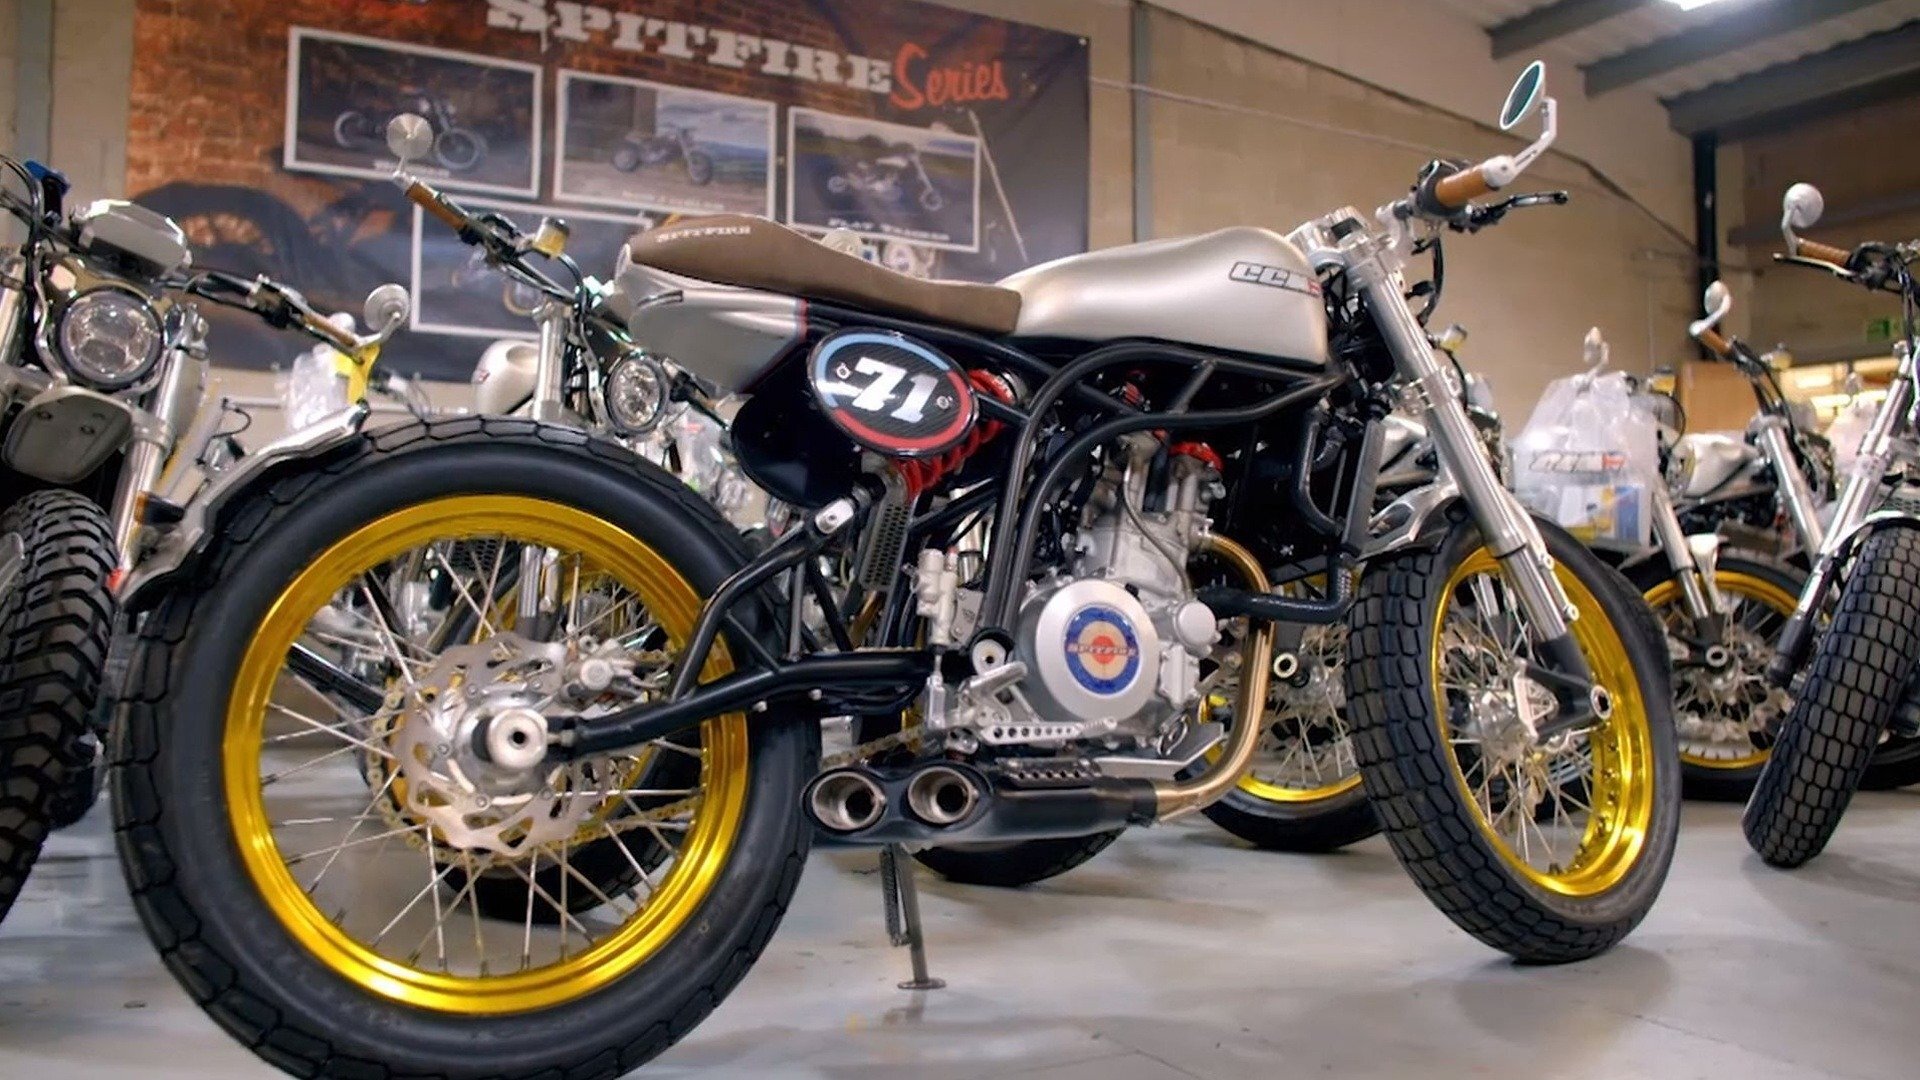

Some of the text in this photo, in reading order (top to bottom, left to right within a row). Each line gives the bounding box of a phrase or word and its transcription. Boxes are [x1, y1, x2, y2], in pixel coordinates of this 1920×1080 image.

[486, 0, 1009, 109] SPITFIRE Series
[656, 226, 750, 242] SPITFIRE
[855, 356, 939, 424] 71
